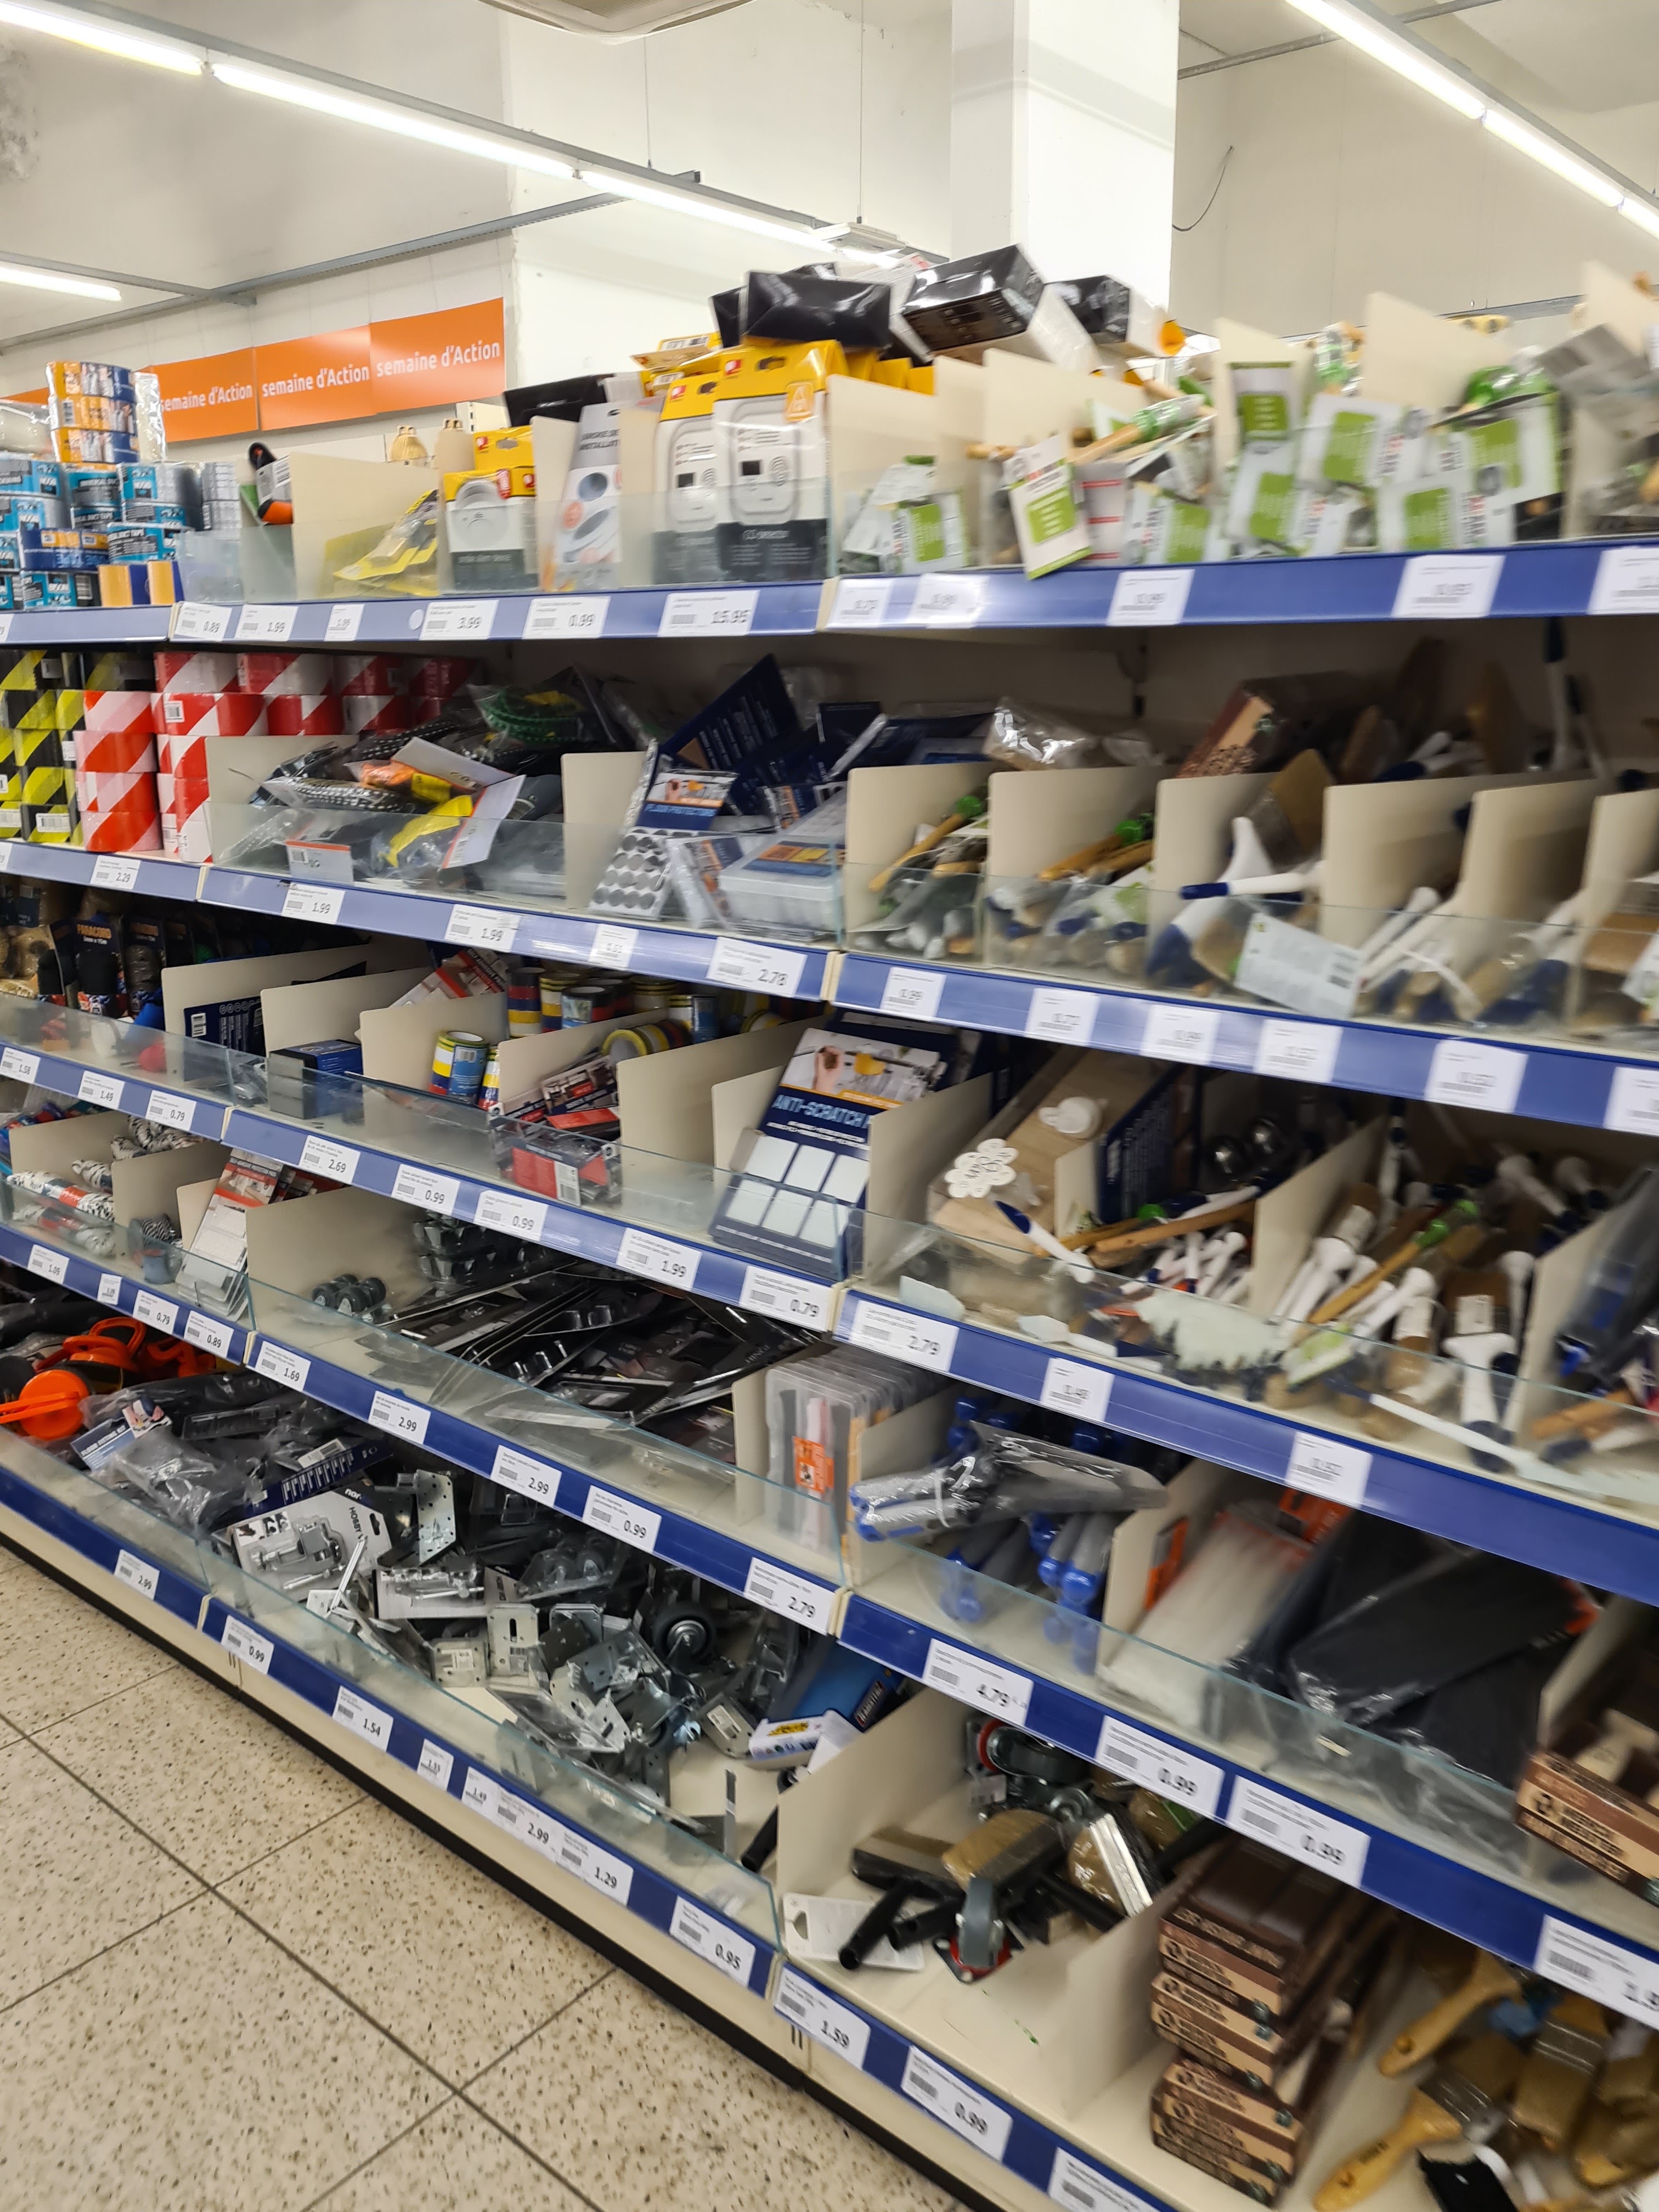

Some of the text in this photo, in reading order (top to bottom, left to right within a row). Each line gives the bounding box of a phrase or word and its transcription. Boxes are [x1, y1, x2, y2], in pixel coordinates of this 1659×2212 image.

[377, 340, 500, 377] semaine d'Action
[262, 364, 370, 398] semaine d'Action
[161, 382, 253, 411] semaine d'Action
[267, 621, 286, 633] 1.99
[116, 872, 132, 884] 2.29
[312, 901, 332, 915] 1.99
[479, 927, 504, 942] 1.99
[171, 1109, 185, 1122] 0.79
[772, 1094, 868, 1129] ANTI-SCRATCH
[328, 1159, 347, 1173] 2.69
[426, 1190, 445, 1205] 0.99
[512, 1215, 534, 1231] 0.99
[660, 1260, 687, 1278] 1.99
[789, 1298, 820, 1317] 0.79
[156, 1312, 170, 1325] 0.79
[207, 1334, 222, 1349] 0.89
[284, 1367, 301, 1382] 1.69
[398, 1417, 417, 1432] 2.99
[528, 1477, 550, 1495] 2.99
[349, 1506, 363, 1534] HOBBY
[623, 1519, 647, 1539] 0.99
[363, 1718, 381, 1737] 1.54
[527, 1822, 549, 1844] 2.99
[594, 1866, 617, 1889] 1.29
[715, 1943, 742, 1971] 0.95
[821, 2019, 850, 2049] 1.59
